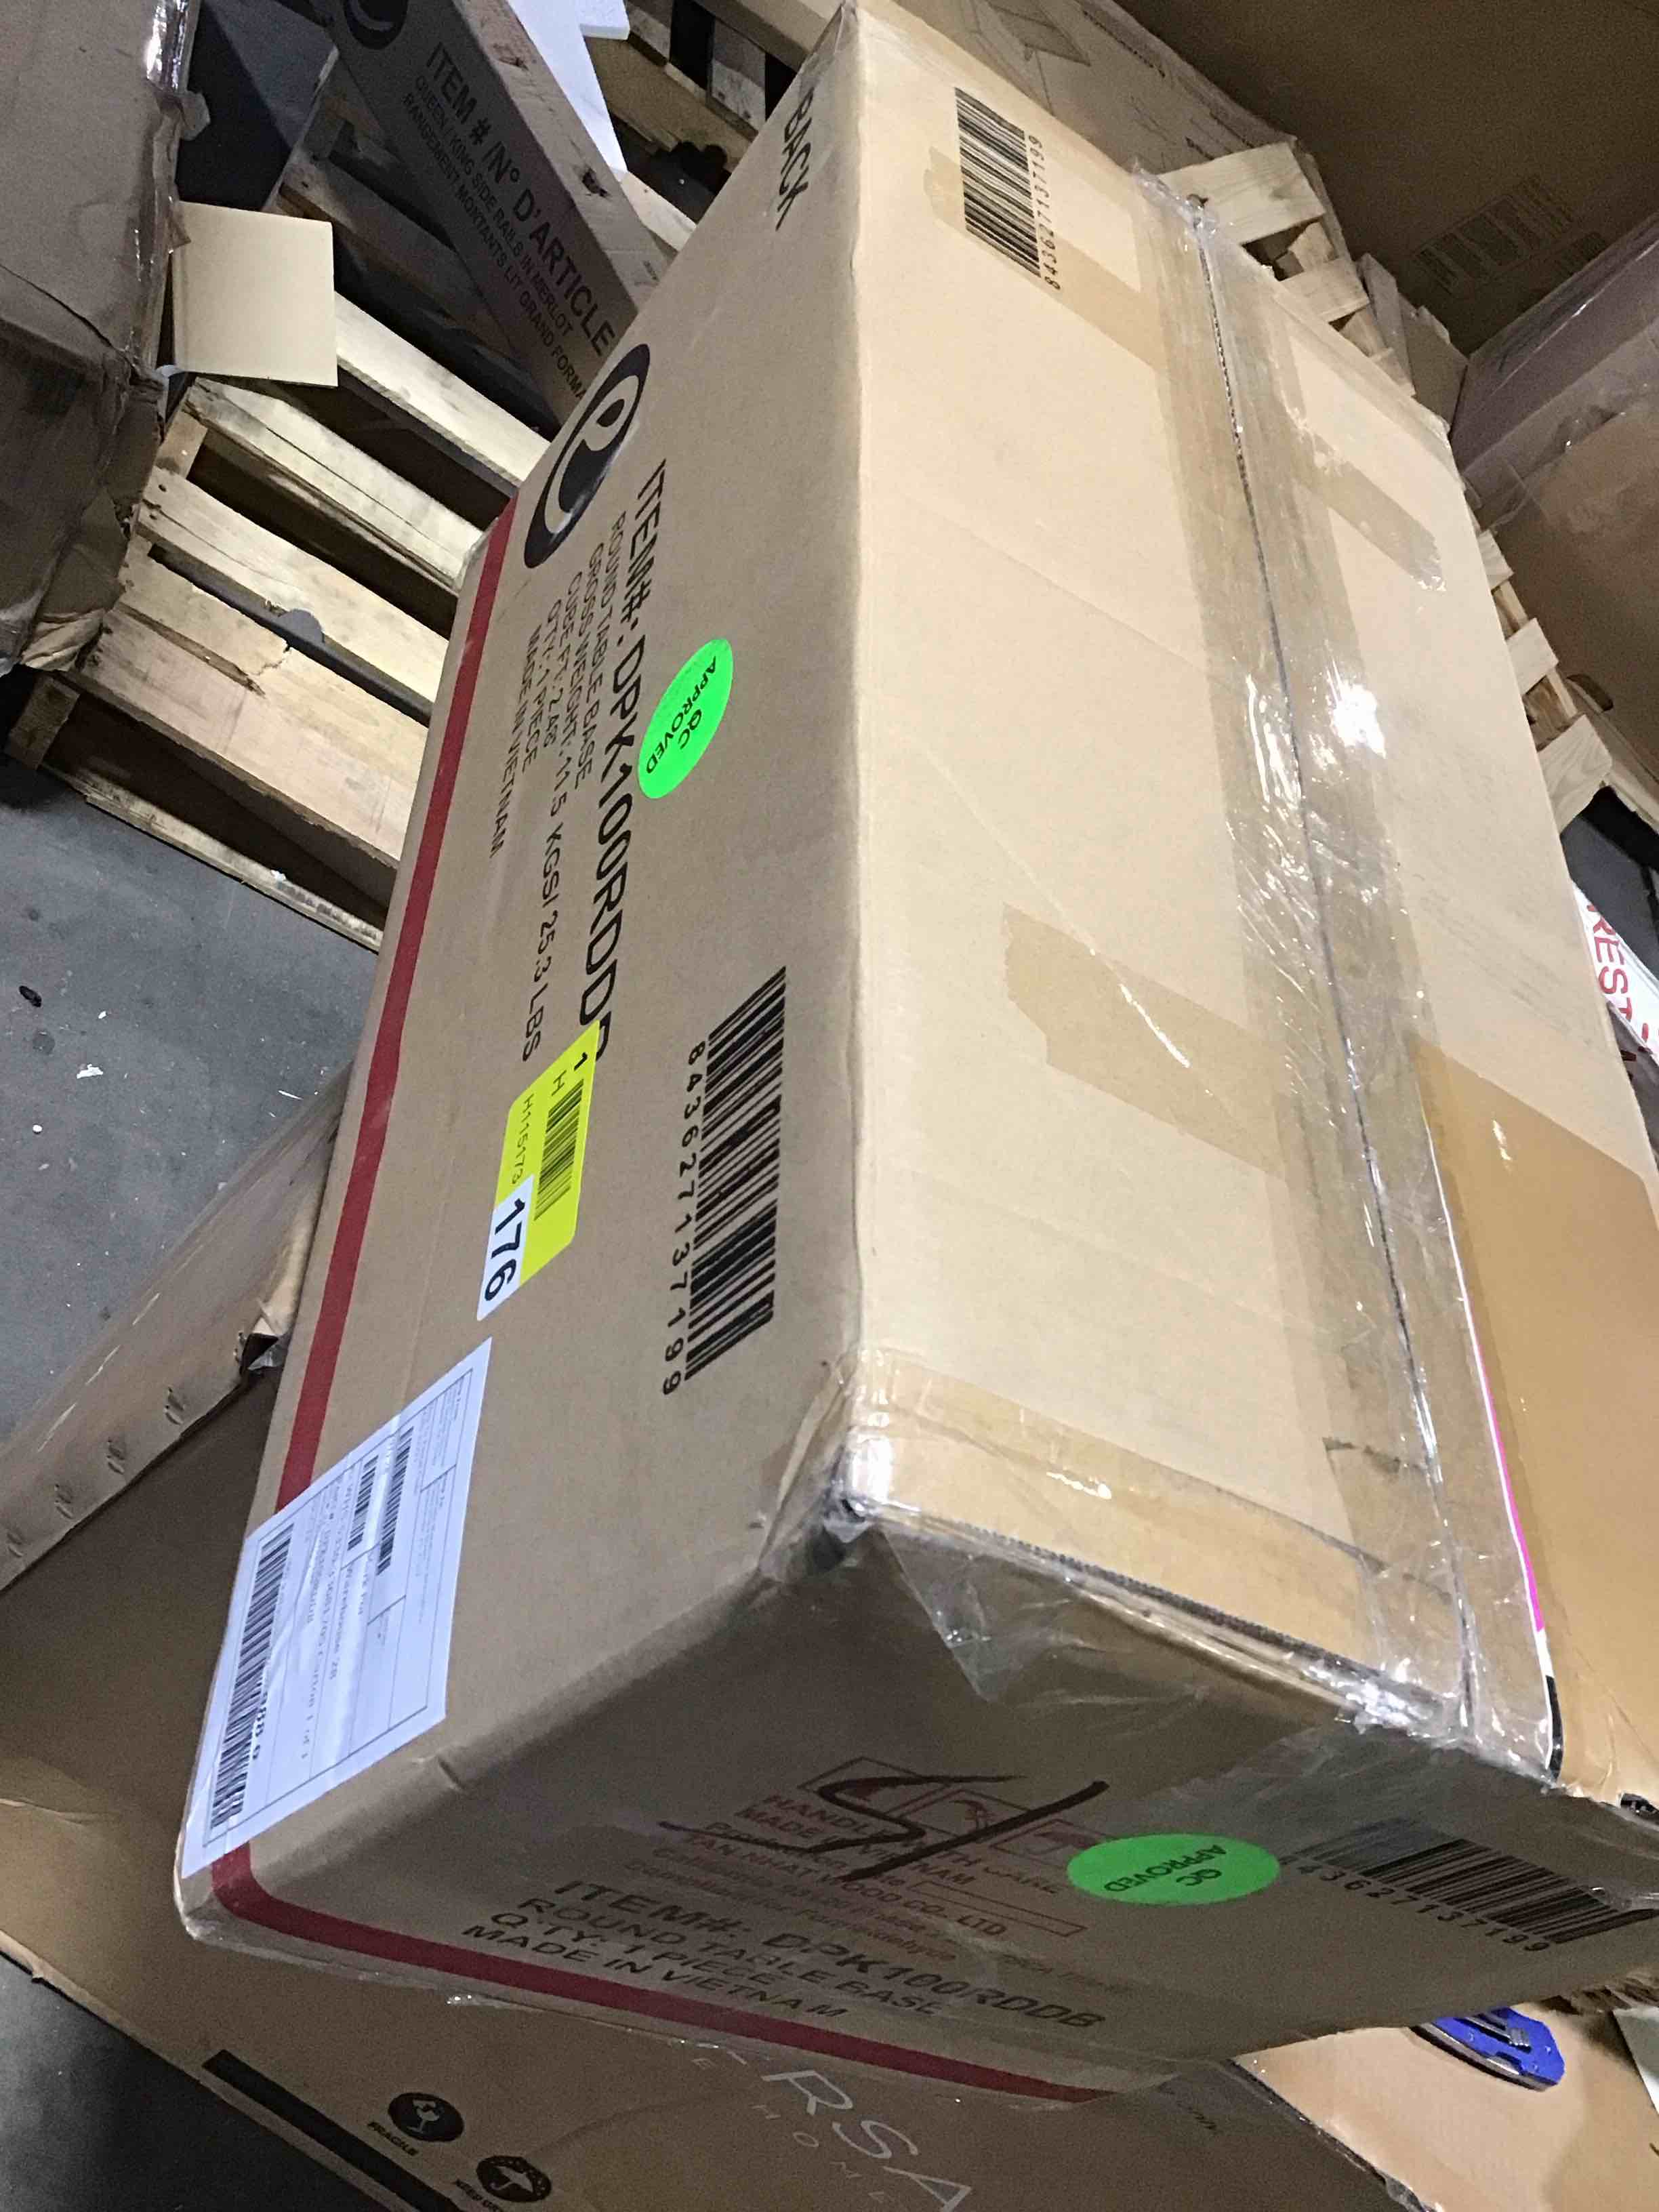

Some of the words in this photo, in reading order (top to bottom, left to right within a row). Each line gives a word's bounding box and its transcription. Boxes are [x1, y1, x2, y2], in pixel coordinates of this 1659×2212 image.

[426, 41, 477, 124] ITEM
[513, 187, 615, 357] D'ARTICLE
[775, 86, 815, 232] BACK
[472, 173, 498, 212] SIDE
[531, 271, 573, 336] MERLOT
[520, 291, 554, 347] GRAND
[579, 543, 604, 637] GROSS
[601, 511, 626, 608] ROUND
[617, 457, 666, 646] ITEM#:
[560, 571, 583, 647] CUBE
[586, 605, 613, 703] TABLE
[519, 623, 542, 702] MADE
[512, 699, 529, 734] IN
[522, 686, 547, 773] PIECE
[575, 699, 600, 790] BASE
[647, 655, 716, 774] APPROVED
[678, 708, 702, 750] QC
[489, 730, 523, 859] VIETNAM
[523, 983, 548, 1062] LBS
[573, 1051, 588, 1071] 1
[551, 1069, 567, 1097] H
[483, 1197, 527, 1302] 176
[663, 1041, 705, 1395] 843627137199
[1104, 1844, 1227, 1891] APPROVED
[1176, 1868, 1222, 1886] QC
[462, 1925, 599, 1962] MADE
[603, 1958, 653, 1973] IN
[661, 1969, 848, 2018] VIETNAM
[517, 1898, 687, 1944] ROUND
[699, 1942, 838, 1984] TABLE
[835, 1980, 943, 2015] BASE
[652, 1951, 784, 1986] PIECE
[367, 2121, 419, 2156] FRAGILE
